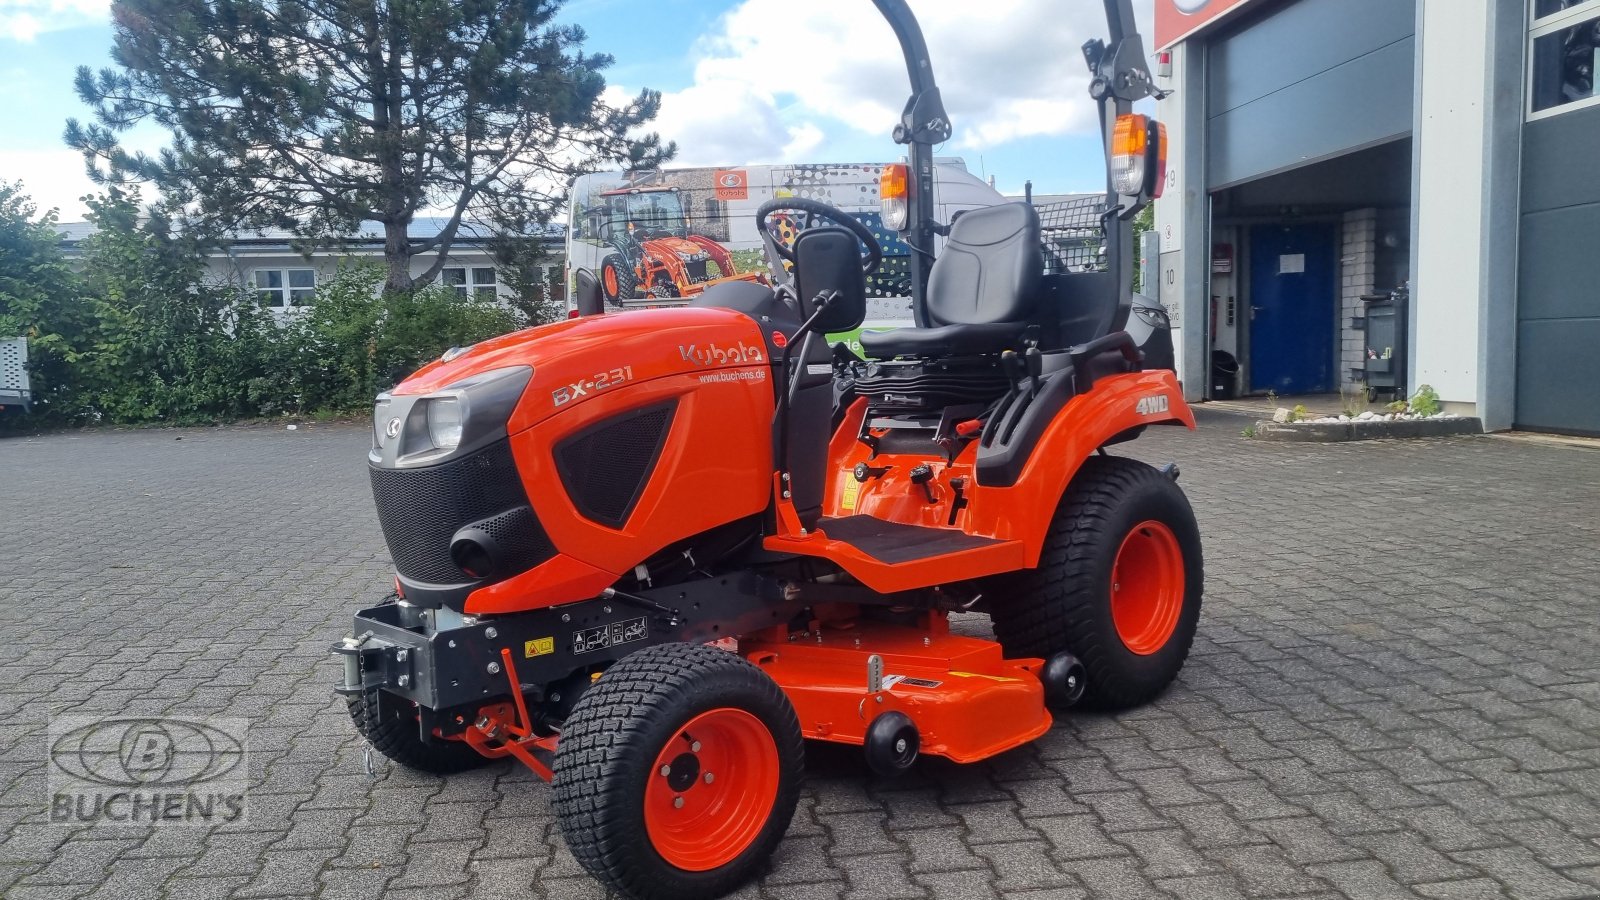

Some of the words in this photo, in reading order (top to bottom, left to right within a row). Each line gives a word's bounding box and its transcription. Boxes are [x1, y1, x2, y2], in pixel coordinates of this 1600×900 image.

[1166, 268, 1175, 285] 10
[679, 341, 763, 366] Kubota
[552, 365, 633, 407] BX-231
[699, 370, 766, 384] www.buchens.de
[1135, 394, 1169, 416] 4WD
